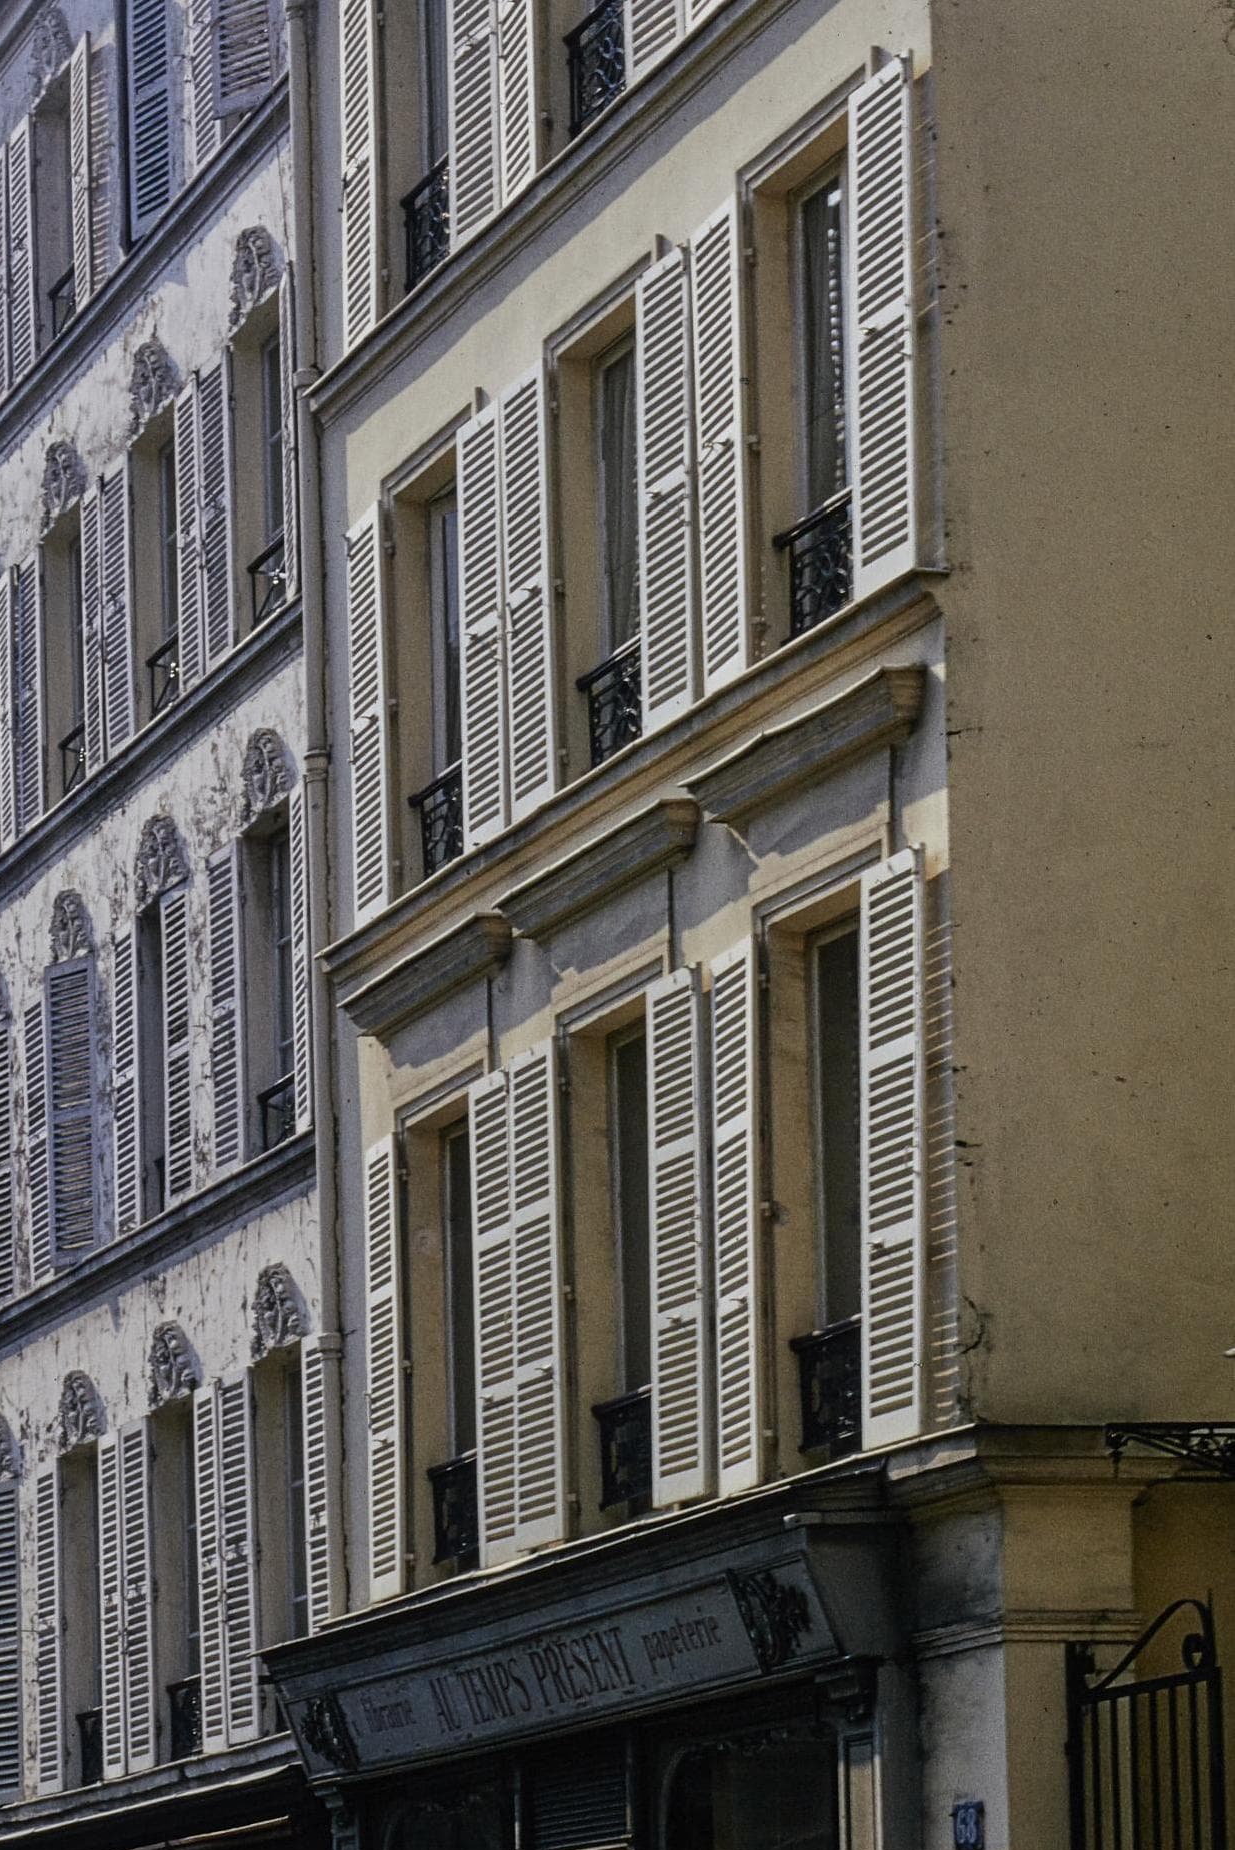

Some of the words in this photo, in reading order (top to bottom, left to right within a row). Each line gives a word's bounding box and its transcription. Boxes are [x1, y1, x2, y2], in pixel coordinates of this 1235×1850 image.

[429, 1675, 461, 1731] AU
[456, 1658, 532, 1726] TEMPS
[641, 1606, 722, 1674] papeterie
[957, 1808, 977, 1844] 68
